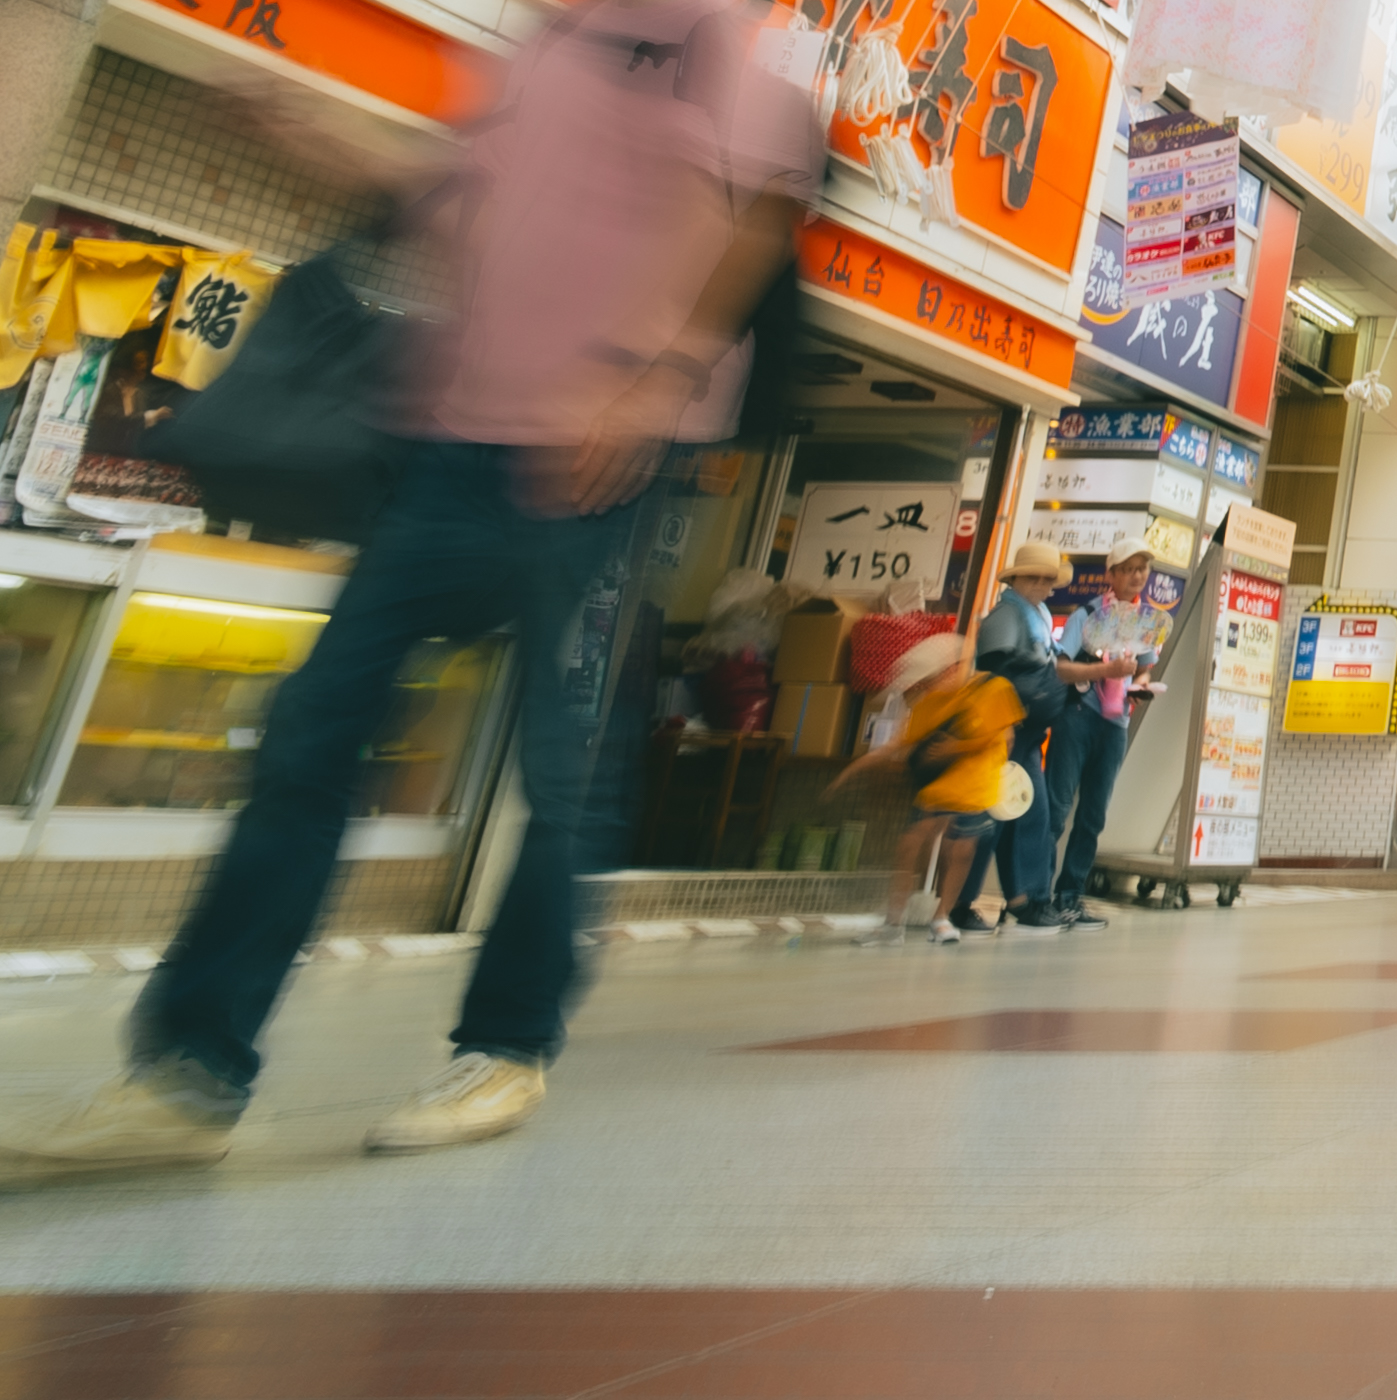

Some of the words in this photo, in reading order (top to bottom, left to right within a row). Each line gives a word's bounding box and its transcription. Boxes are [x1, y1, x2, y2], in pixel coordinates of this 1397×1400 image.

[820, 239, 885, 298] 仙台
[915, 277, 1037, 371] 日乃出寿司
[1088, 413, 1162, 438] 漁業部
[1168, 433, 1196, 460] こちら
[824, 500, 929, 533] 一皿
[822, 550, 912, 581] ¥150
